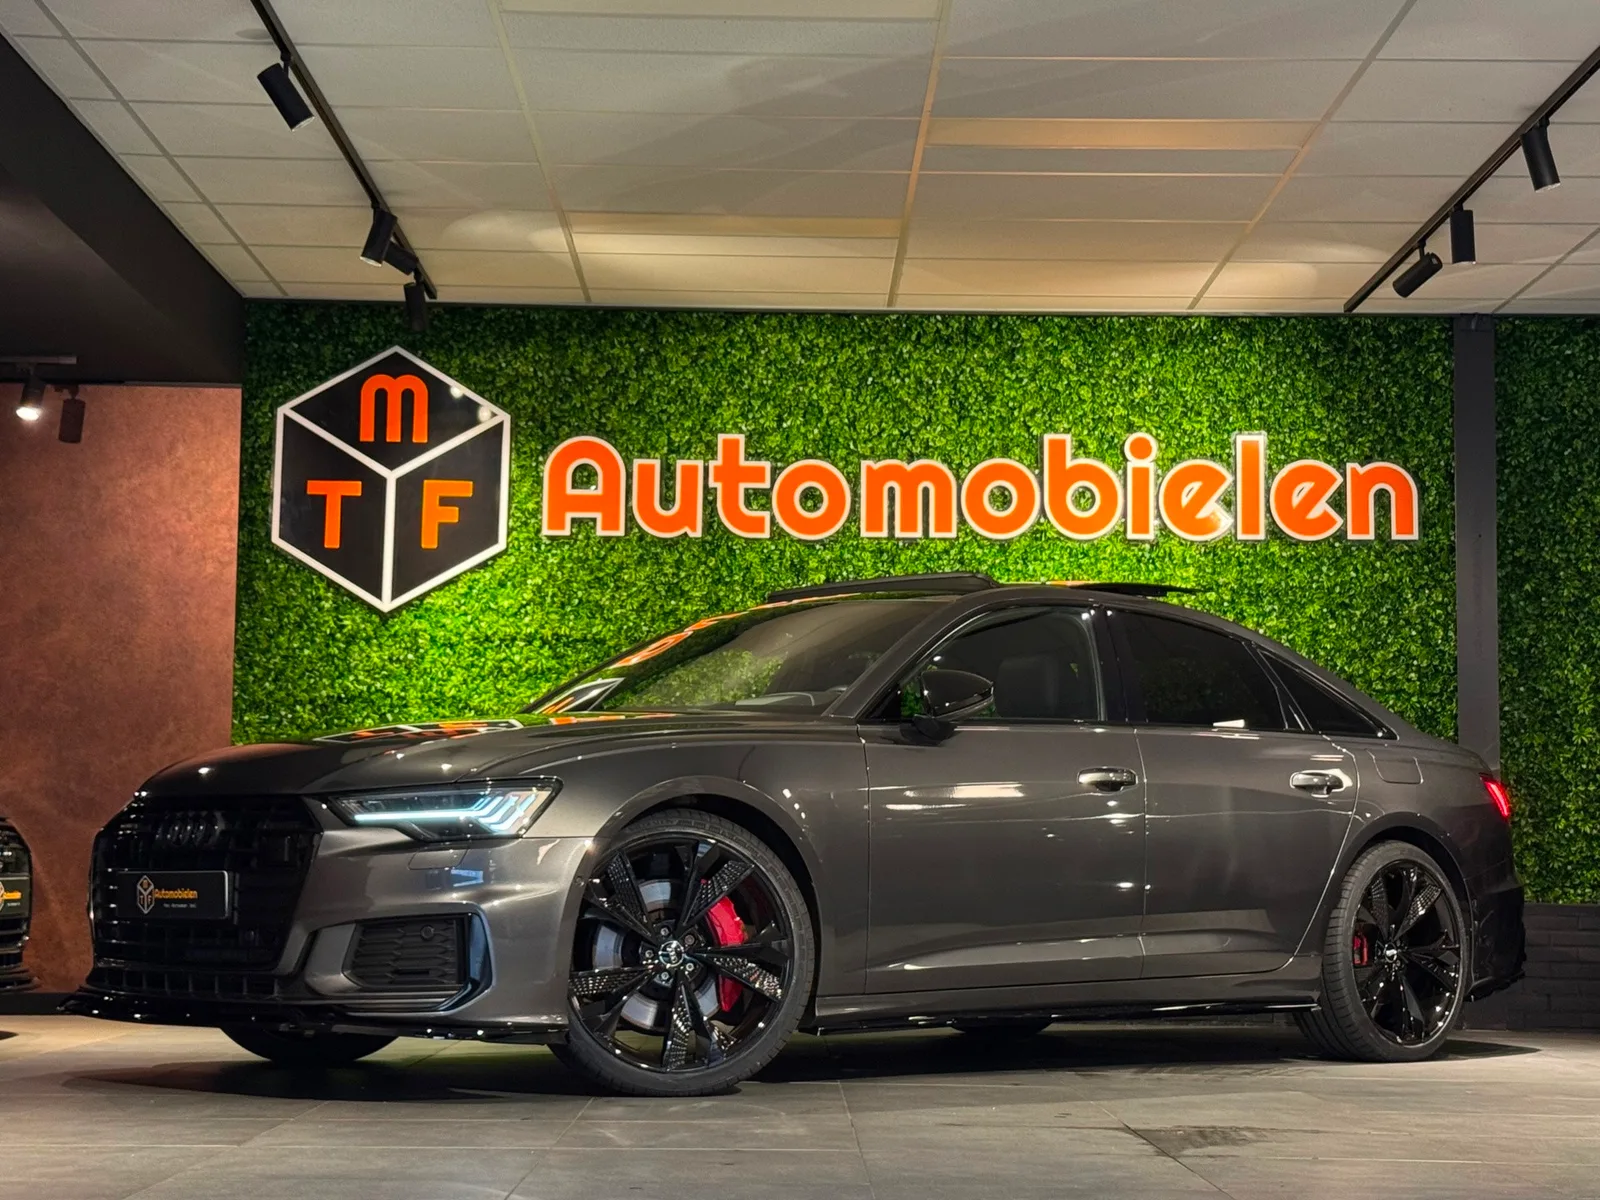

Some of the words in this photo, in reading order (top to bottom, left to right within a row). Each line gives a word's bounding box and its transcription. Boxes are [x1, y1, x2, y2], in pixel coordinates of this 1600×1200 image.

[306, 479, 362, 549] T
[421, 479, 474, 549] F
[541, 432, 1419, 541] Automobielen
